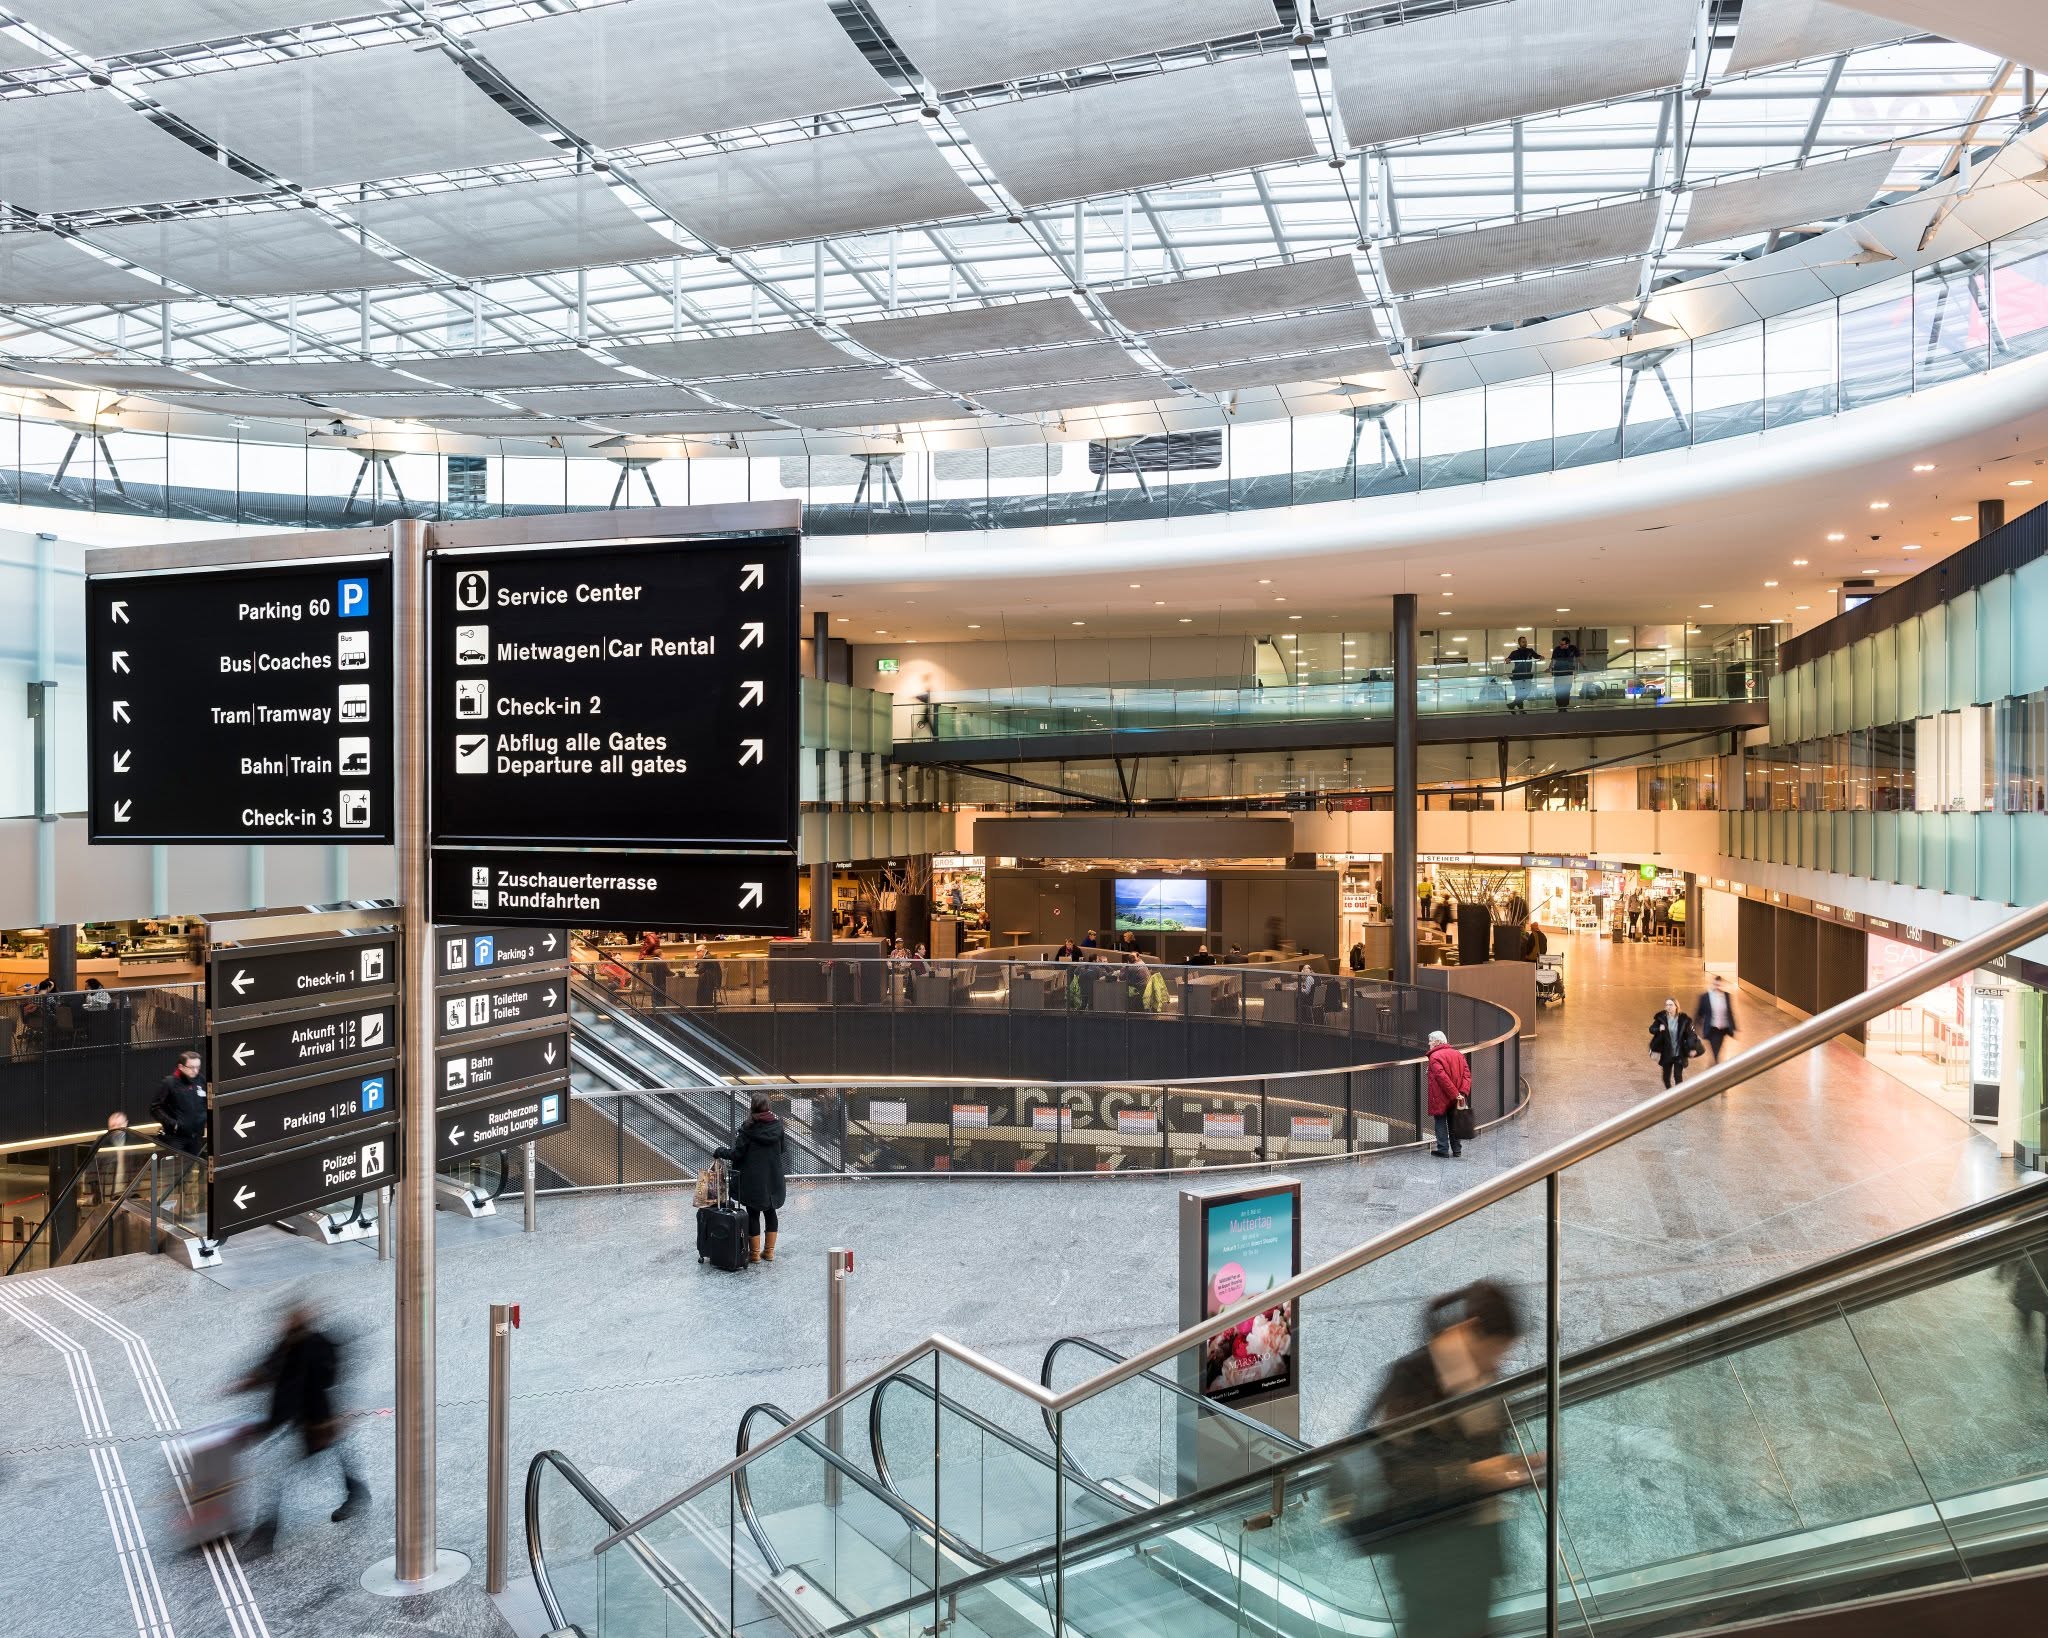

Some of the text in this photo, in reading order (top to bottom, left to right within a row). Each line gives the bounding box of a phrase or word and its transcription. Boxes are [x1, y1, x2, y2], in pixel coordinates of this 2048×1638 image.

[345, 584, 362, 613] P
[498, 584, 641, 606] Service Center
[240, 599, 329, 620] Parking 60
[652, 636, 714, 656] Rental
[497, 696, 600, 715] Check-in 2
[497, 732, 666, 755] Abflug alle Gates
[498, 755, 686, 776] Departure all gates
[243, 809, 332, 825] Check-in 3
[498, 871, 657, 890] Zuschauerterrasse
[499, 892, 599, 909] Rundfahrten
[1906, 925, 1922, 942] CHRIST
[480, 945, 489, 963] P
[498, 946, 535, 960] Parking 3
[297, 970, 355, 989] Check-in 1
[493, 993, 527, 1005] Toiletten
[493, 1006, 519, 1019] Toilets
[292, 1025, 336, 1043] Ankunft
[299, 1040, 335, 1058] Arrival
[471, 1057, 493, 1070] Bahn
[471, 1070, 492, 1083] Train
[369, 1091, 379, 1108] P
[284, 1112, 325, 1130] Parking
[489, 1103, 538, 1125] Raucherzone
[473, 1116, 538, 1144] Smoking Lounge
[323, 1154, 357, 1171] Polizei
[325, 1168, 357, 1187] Police
[1230, 1216, 1272, 1233] Muttertag
[1229, 1352, 1271, 1369] MARSANO
